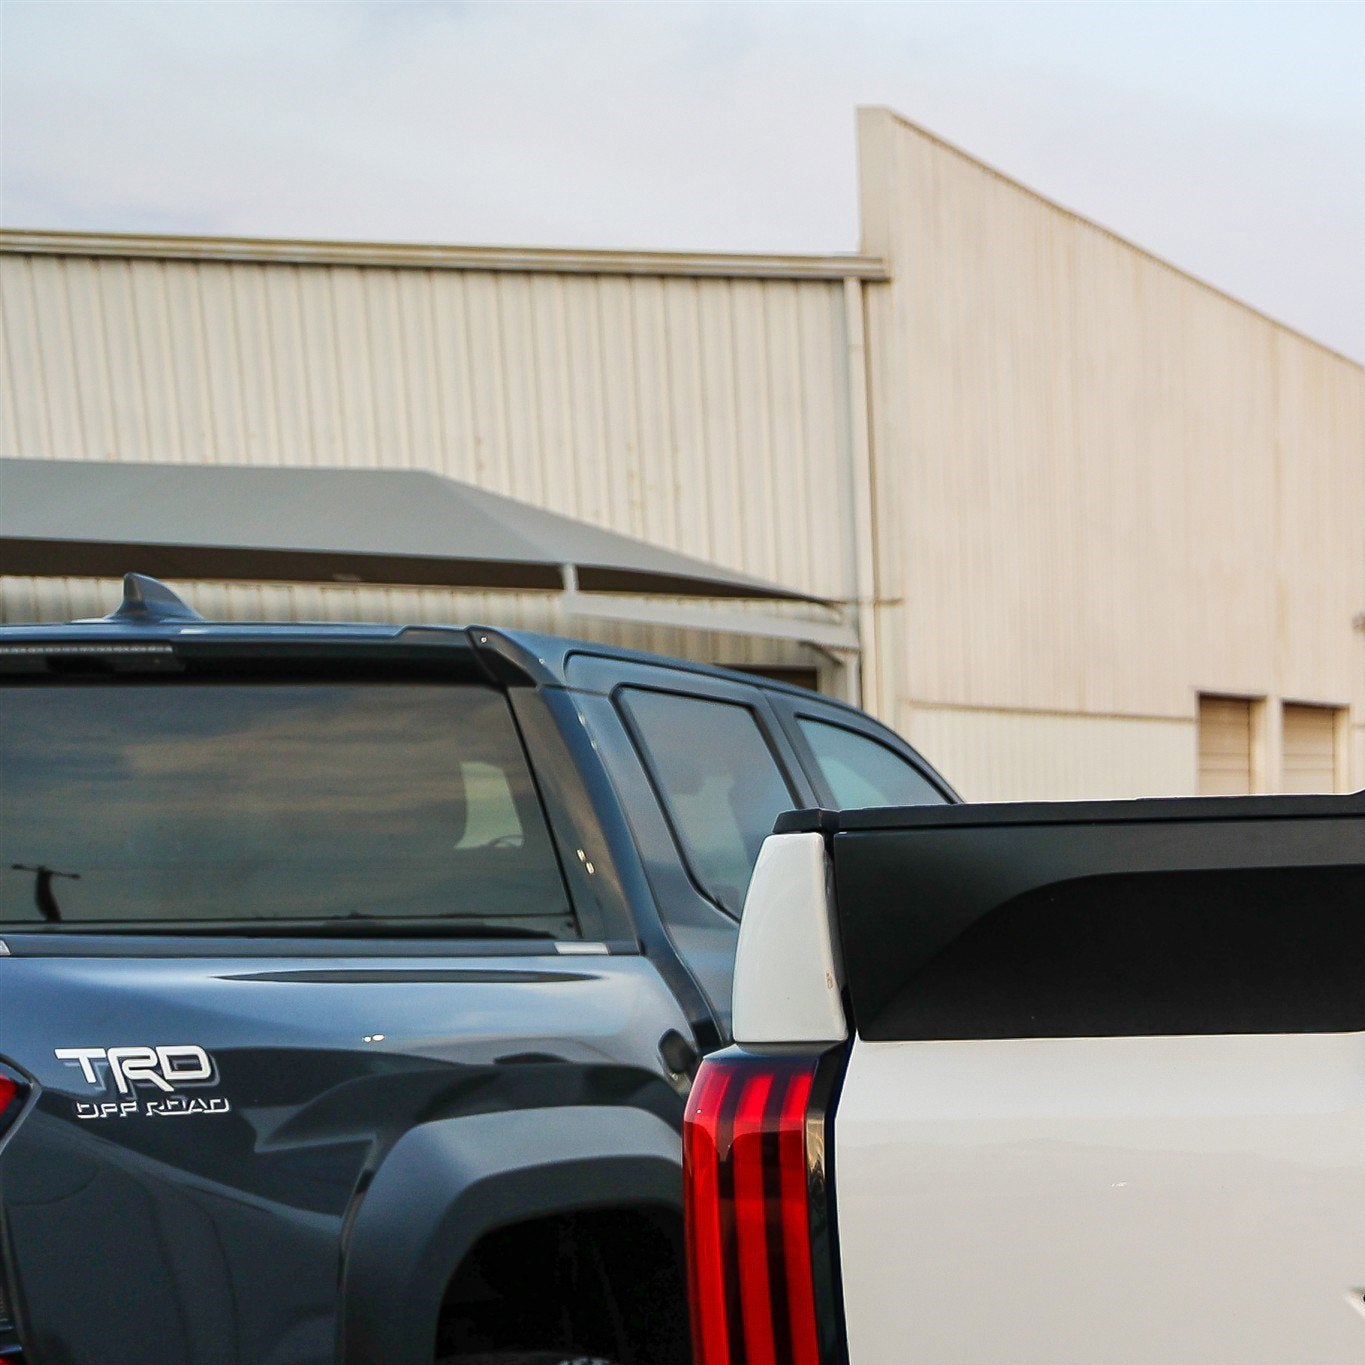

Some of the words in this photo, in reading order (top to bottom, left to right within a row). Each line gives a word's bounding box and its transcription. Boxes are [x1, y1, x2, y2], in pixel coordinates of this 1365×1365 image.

[54, 1045, 212, 1093] TRD
[77, 1101, 137, 1118] OFF
[146, 1098, 230, 1116] ROAD
